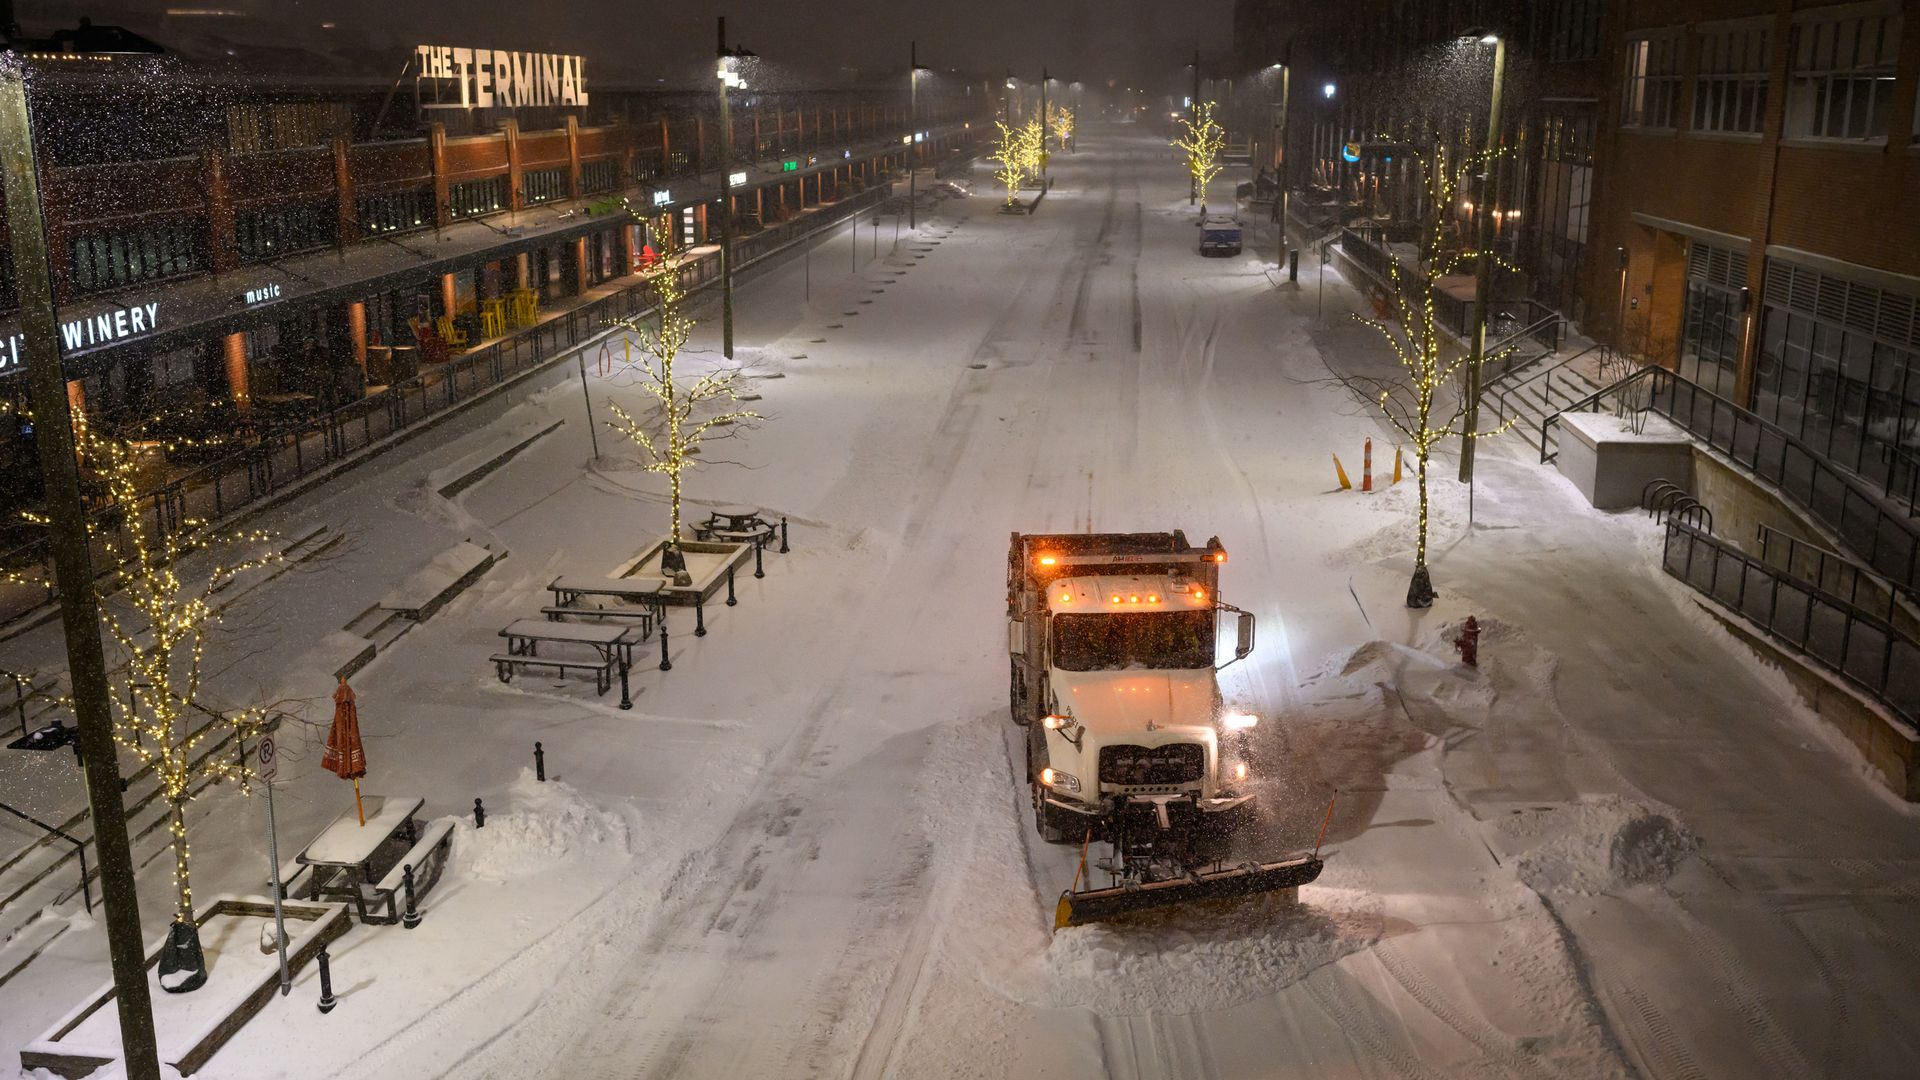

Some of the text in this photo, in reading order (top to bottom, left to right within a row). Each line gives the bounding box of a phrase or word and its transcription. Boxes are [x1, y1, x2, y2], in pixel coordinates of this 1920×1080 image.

[418, 45, 588, 108] THE TERMINAL
[246, 282, 280, 304] music
[62, 302, 158, 351] WINERY
